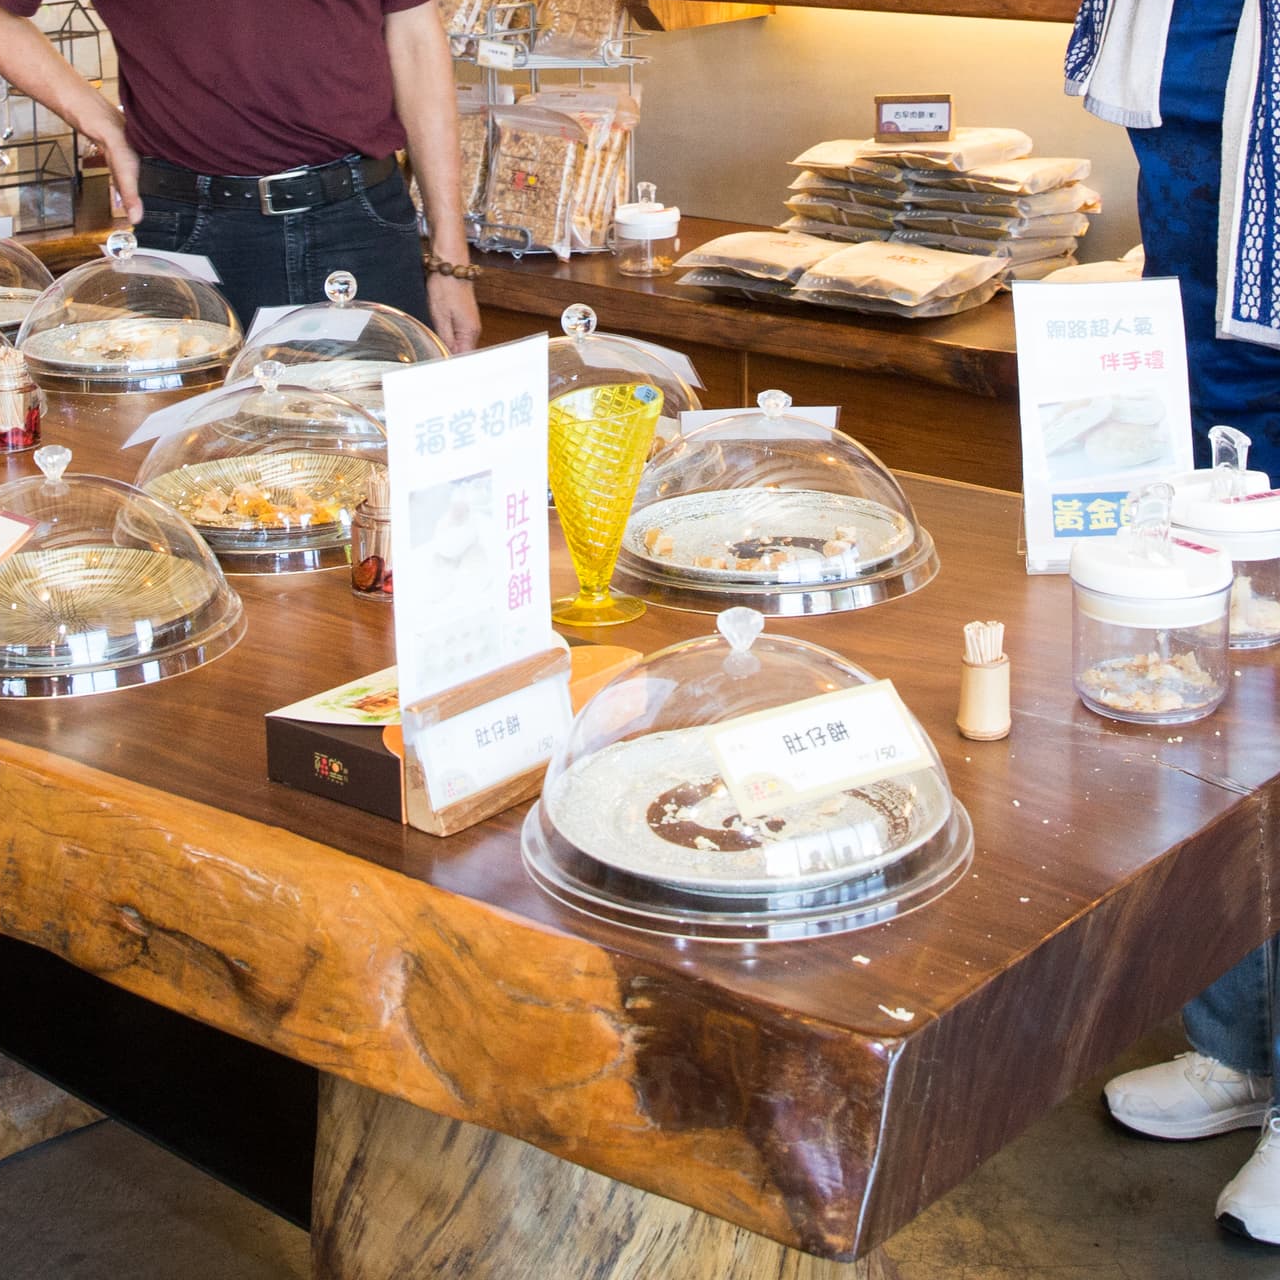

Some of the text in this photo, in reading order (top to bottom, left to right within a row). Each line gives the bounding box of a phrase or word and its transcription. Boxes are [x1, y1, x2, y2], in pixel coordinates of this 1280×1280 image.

[1045, 317, 1154, 340] 網路超人氣
[1100, 350, 1165, 372] 伴手禮
[414, 391, 534, 458] 福堂招牌
[505, 489, 533, 610] 肚仔餅
[475, 714, 520, 748] 肚仔餅
[782, 720, 850, 755] 肚仔餅
[874, 745, 897, 762] 150
